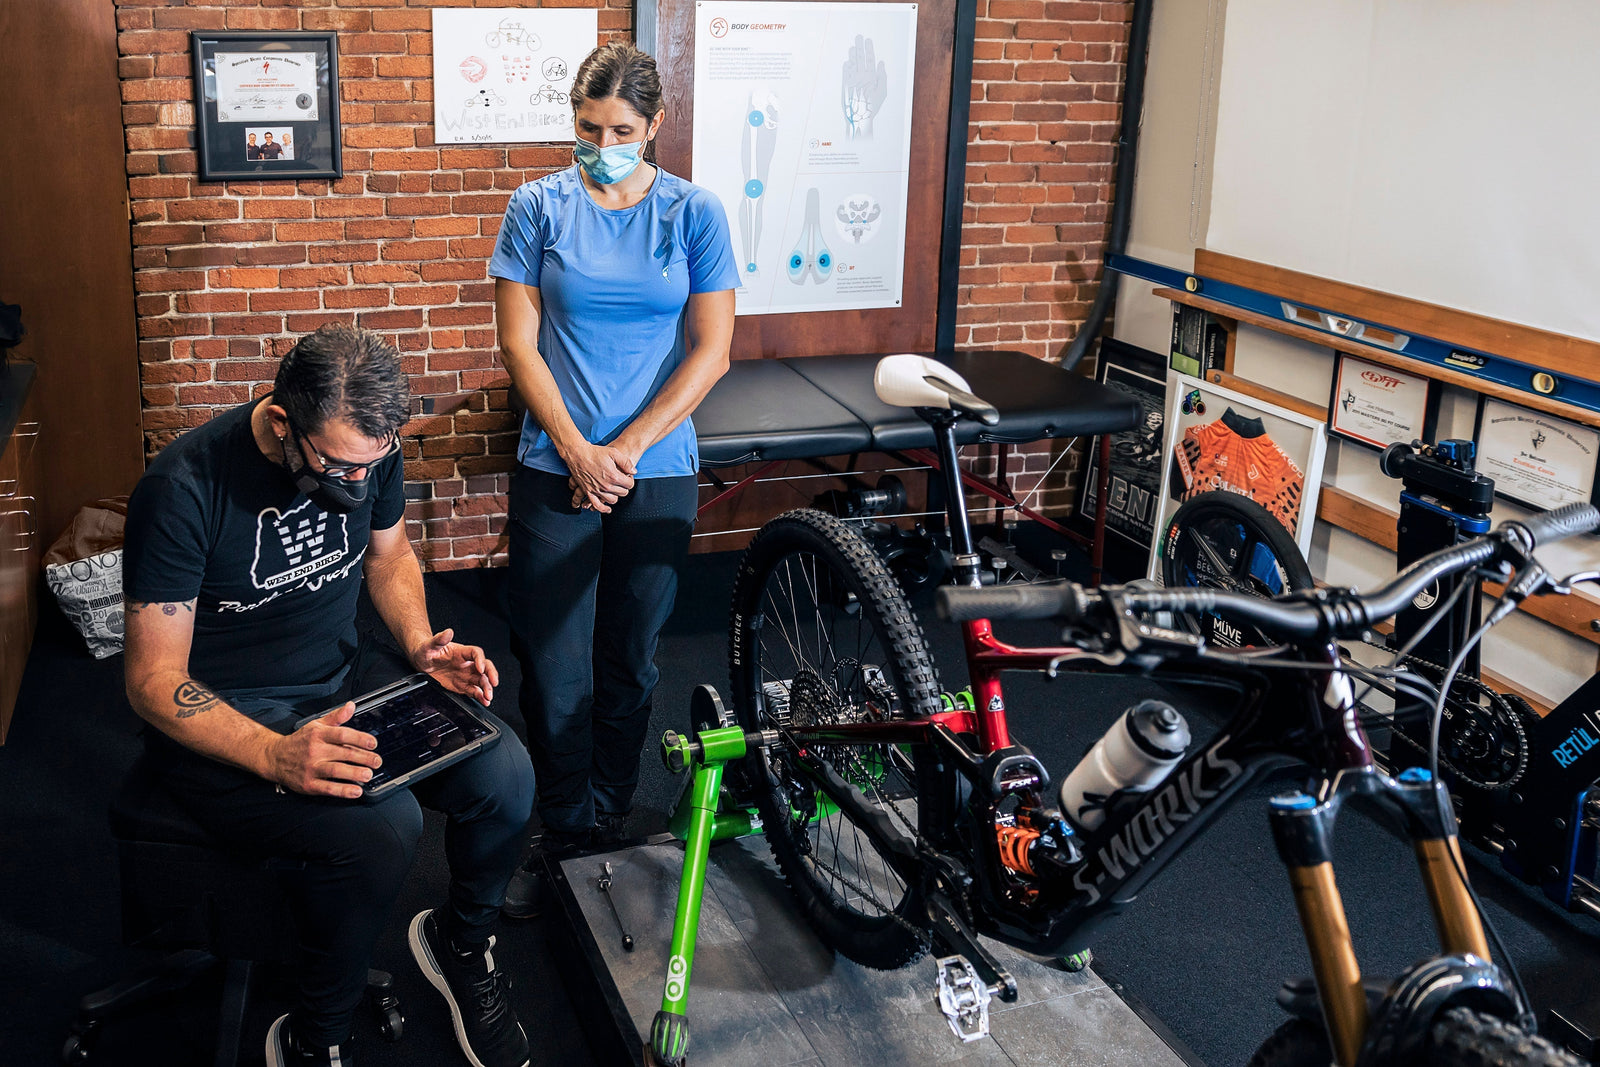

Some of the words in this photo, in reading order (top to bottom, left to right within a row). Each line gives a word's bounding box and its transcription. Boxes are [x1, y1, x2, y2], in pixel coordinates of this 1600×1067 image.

[749, 23, 787, 31] GEOMETRY
[440, 109, 492, 131] West
[494, 112, 524, 130] End
[527, 111, 566, 128] Bikes
[1360, 411, 1380, 422] MASTERS
[1394, 422, 1410, 431] COURSE
[266, 572, 293, 589] WEST
[293, 564, 314, 577] END
[314, 552, 342, 570] BIKES
[92, 609, 108, 621] POI
[733, 613, 743, 665] BUTCHER
[1212, 617, 1242, 644] MÜVE
[1551, 727, 1599, 769] RETÜL
[1008, 778, 1032, 789] FSR
[1073, 734, 1243, 907] S-WORKS
[944, 914, 961, 932] XTR
